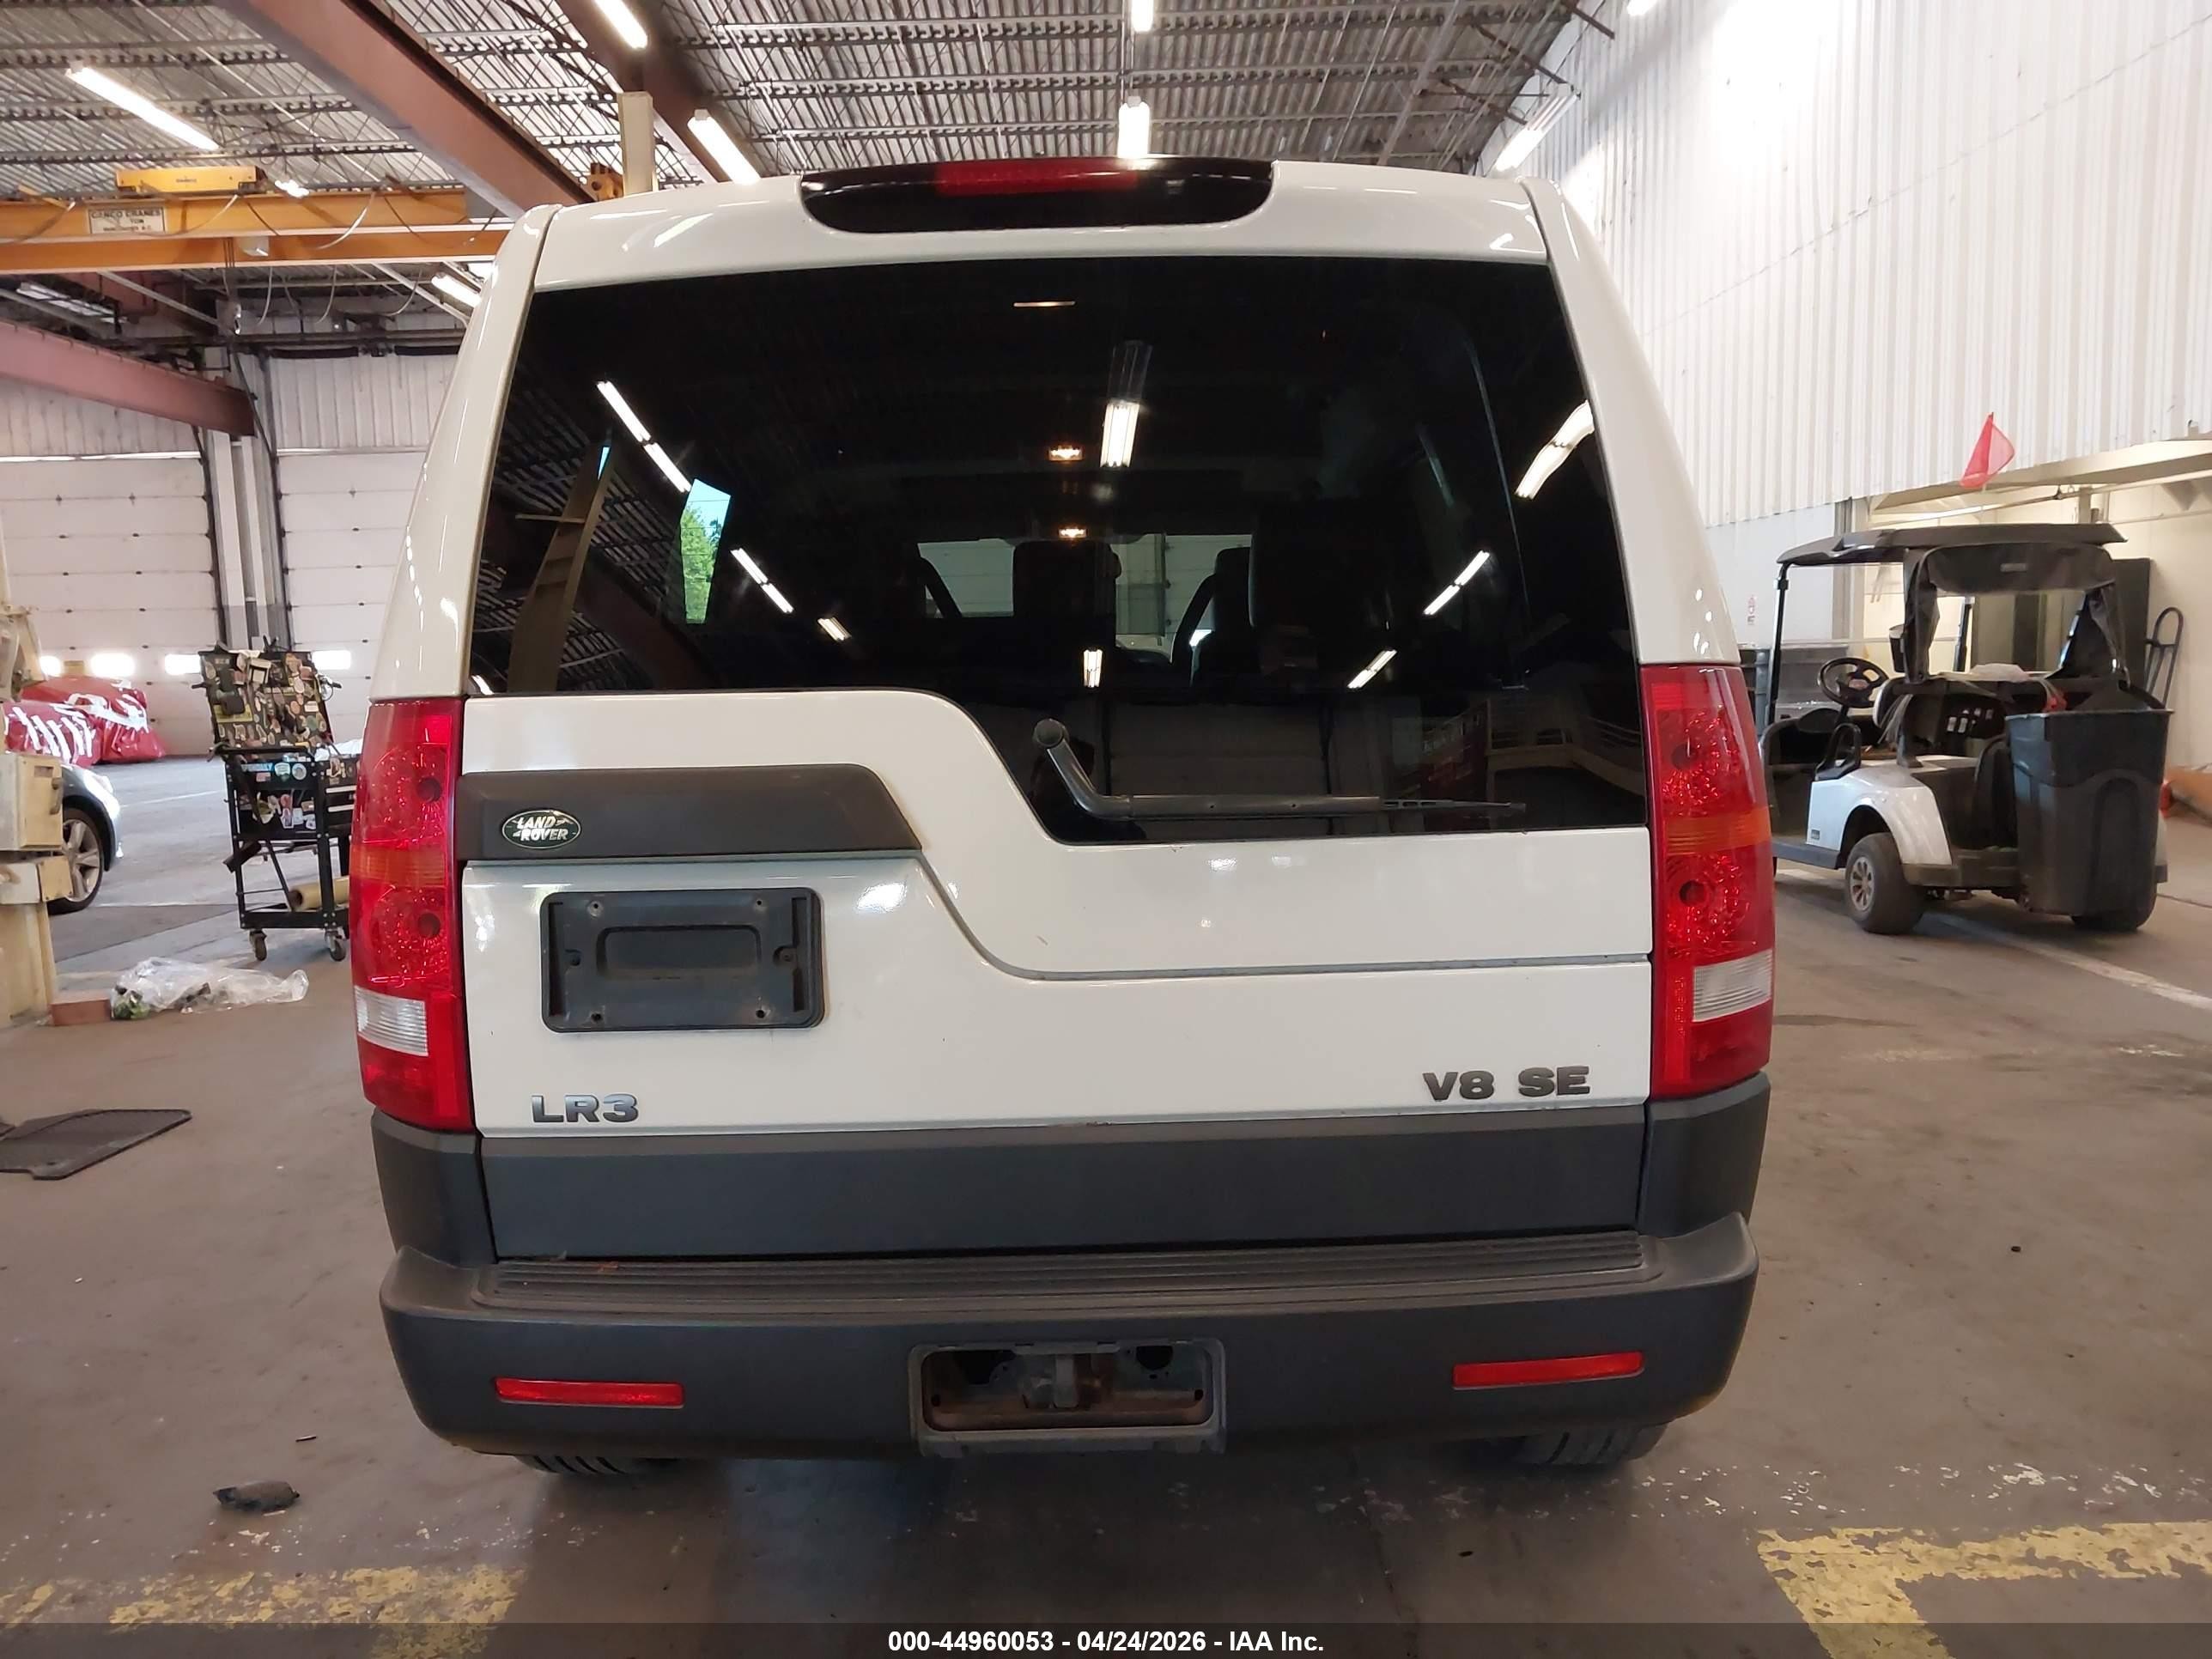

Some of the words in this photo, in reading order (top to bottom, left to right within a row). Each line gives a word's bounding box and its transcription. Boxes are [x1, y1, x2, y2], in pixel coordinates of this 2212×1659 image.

[516, 816, 556, 830] LAND
[520, 828, 568, 841] ROVER
[1422, 1071, 1494, 1101] V8
[1518, 1066, 1590, 1097] SE
[532, 1093, 639, 1123] LR3
